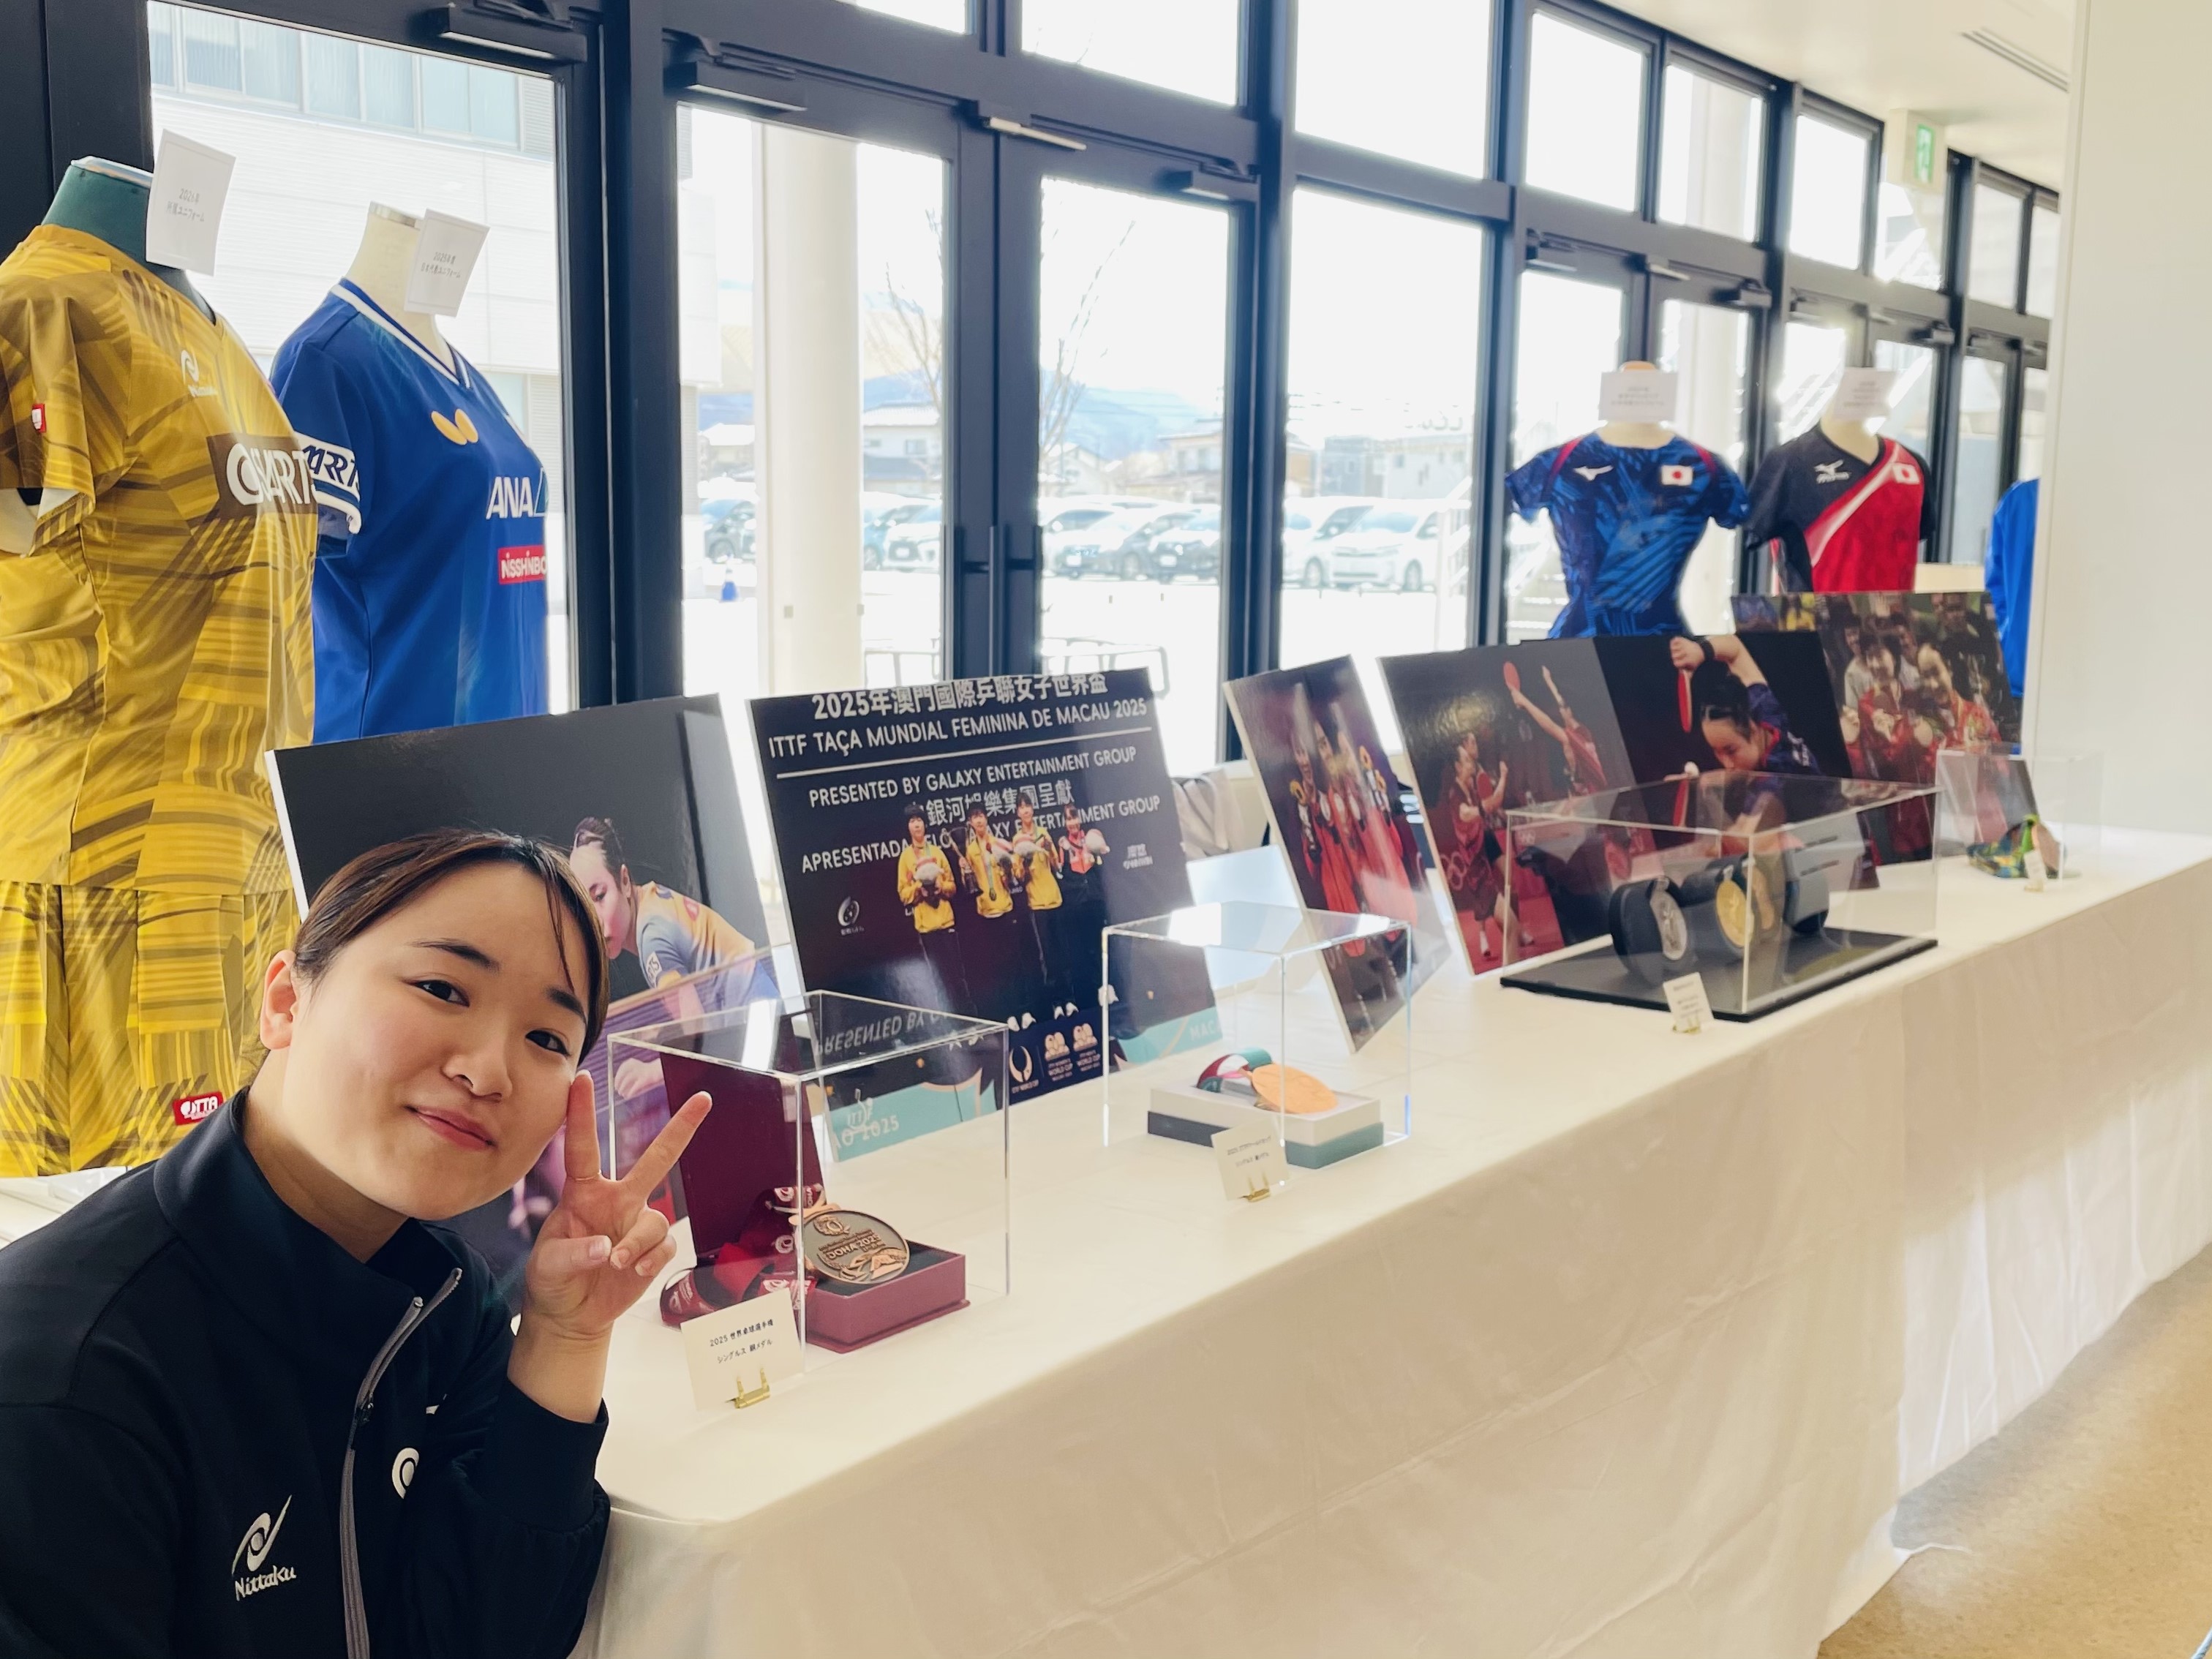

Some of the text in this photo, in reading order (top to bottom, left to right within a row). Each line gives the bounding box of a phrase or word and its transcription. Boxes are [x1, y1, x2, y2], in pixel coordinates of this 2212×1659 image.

[486, 476, 534, 519] ANA
[769, 697, 1147, 758] ITTF TAÇA MUNDIAL FEMININA DE MACAU 2025
[809, 746, 1137, 808] PRESENTED BY GALAXY ENTERTAINMENT GROUP
[1118, 795, 1161, 816] GROUP
[710, 1334, 729, 1347] 2025
[235, 1565, 297, 1601] Nittaku
